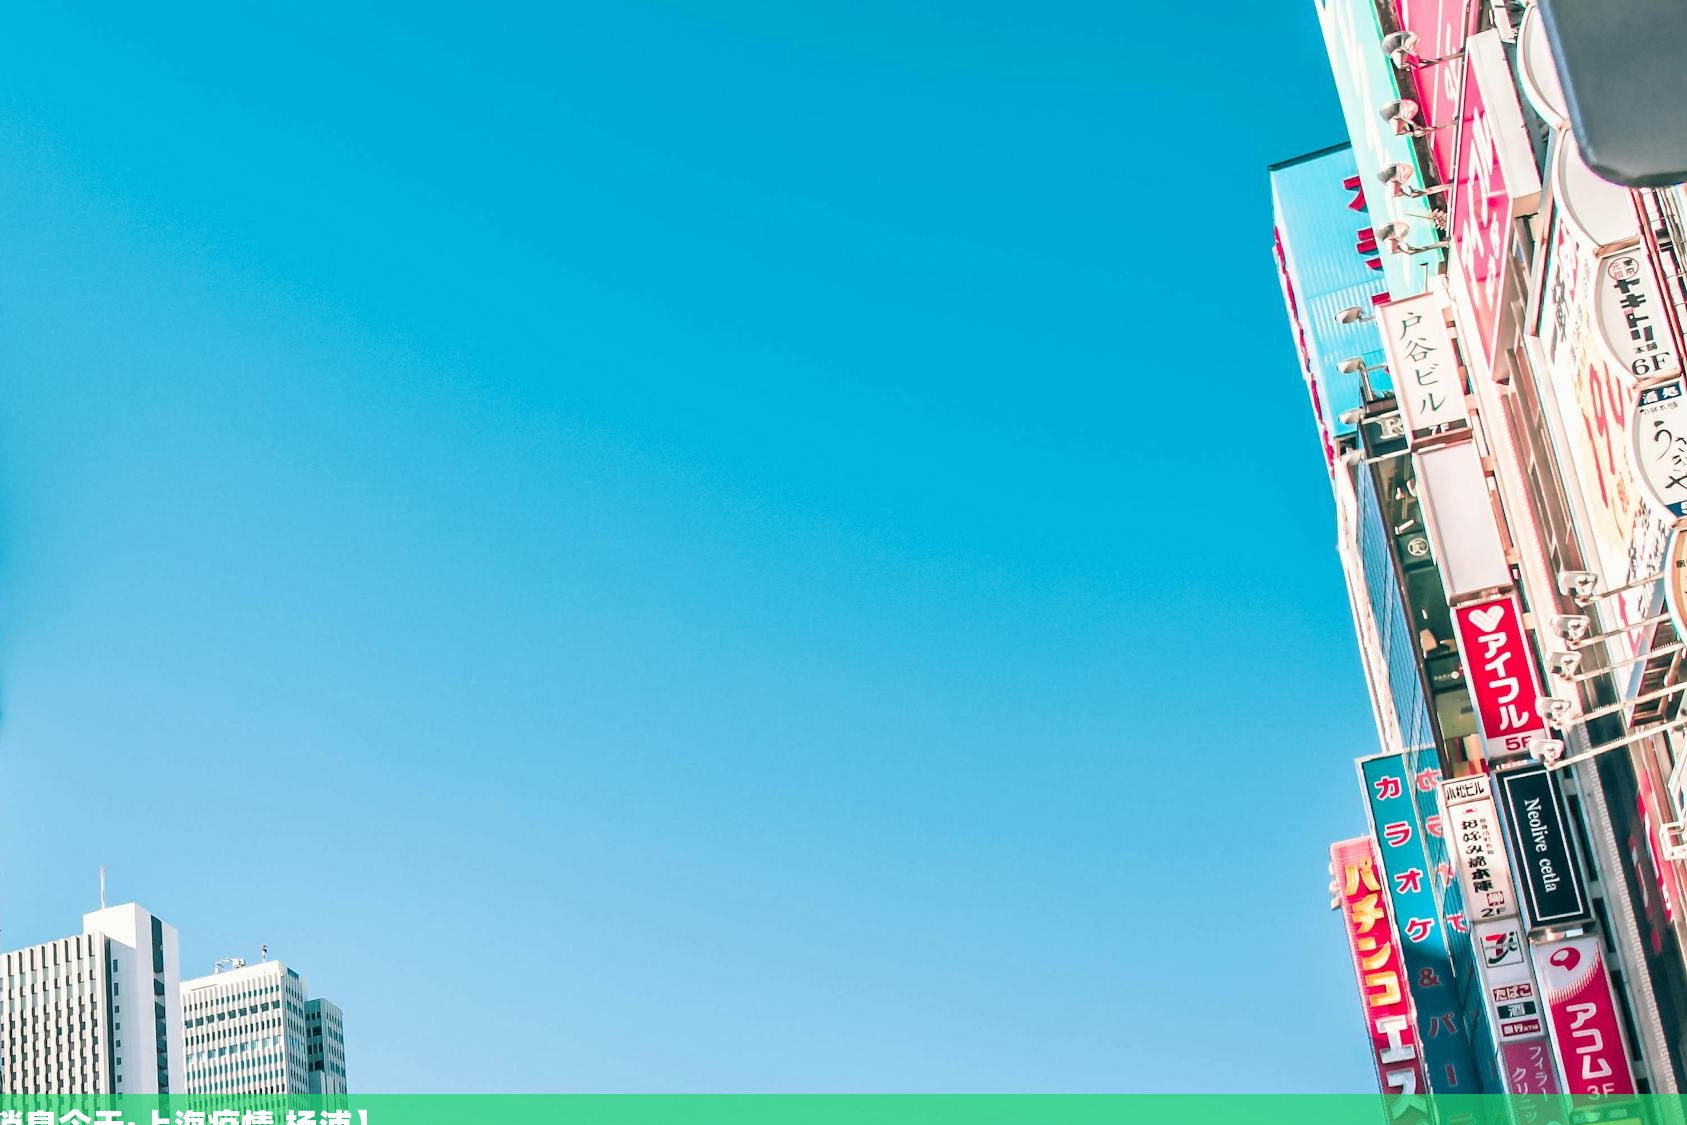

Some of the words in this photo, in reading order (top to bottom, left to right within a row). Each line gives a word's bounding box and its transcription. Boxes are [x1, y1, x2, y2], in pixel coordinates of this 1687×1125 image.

[1399, 310, 1447, 415] 戸谷ビル
[1631, 351, 1671, 377] 6F
[1477, 634, 1530, 732] アイフル
[1504, 735, 1533, 752] 5F
[1524, 797, 1548, 852] Neolive
[1539, 857, 1561, 893] cetla
[1493, 983, 1533, 1001] たばこ
[1565, 1001, 1613, 1079] アコム
[1587, 1083, 1615, 1101] 3F
